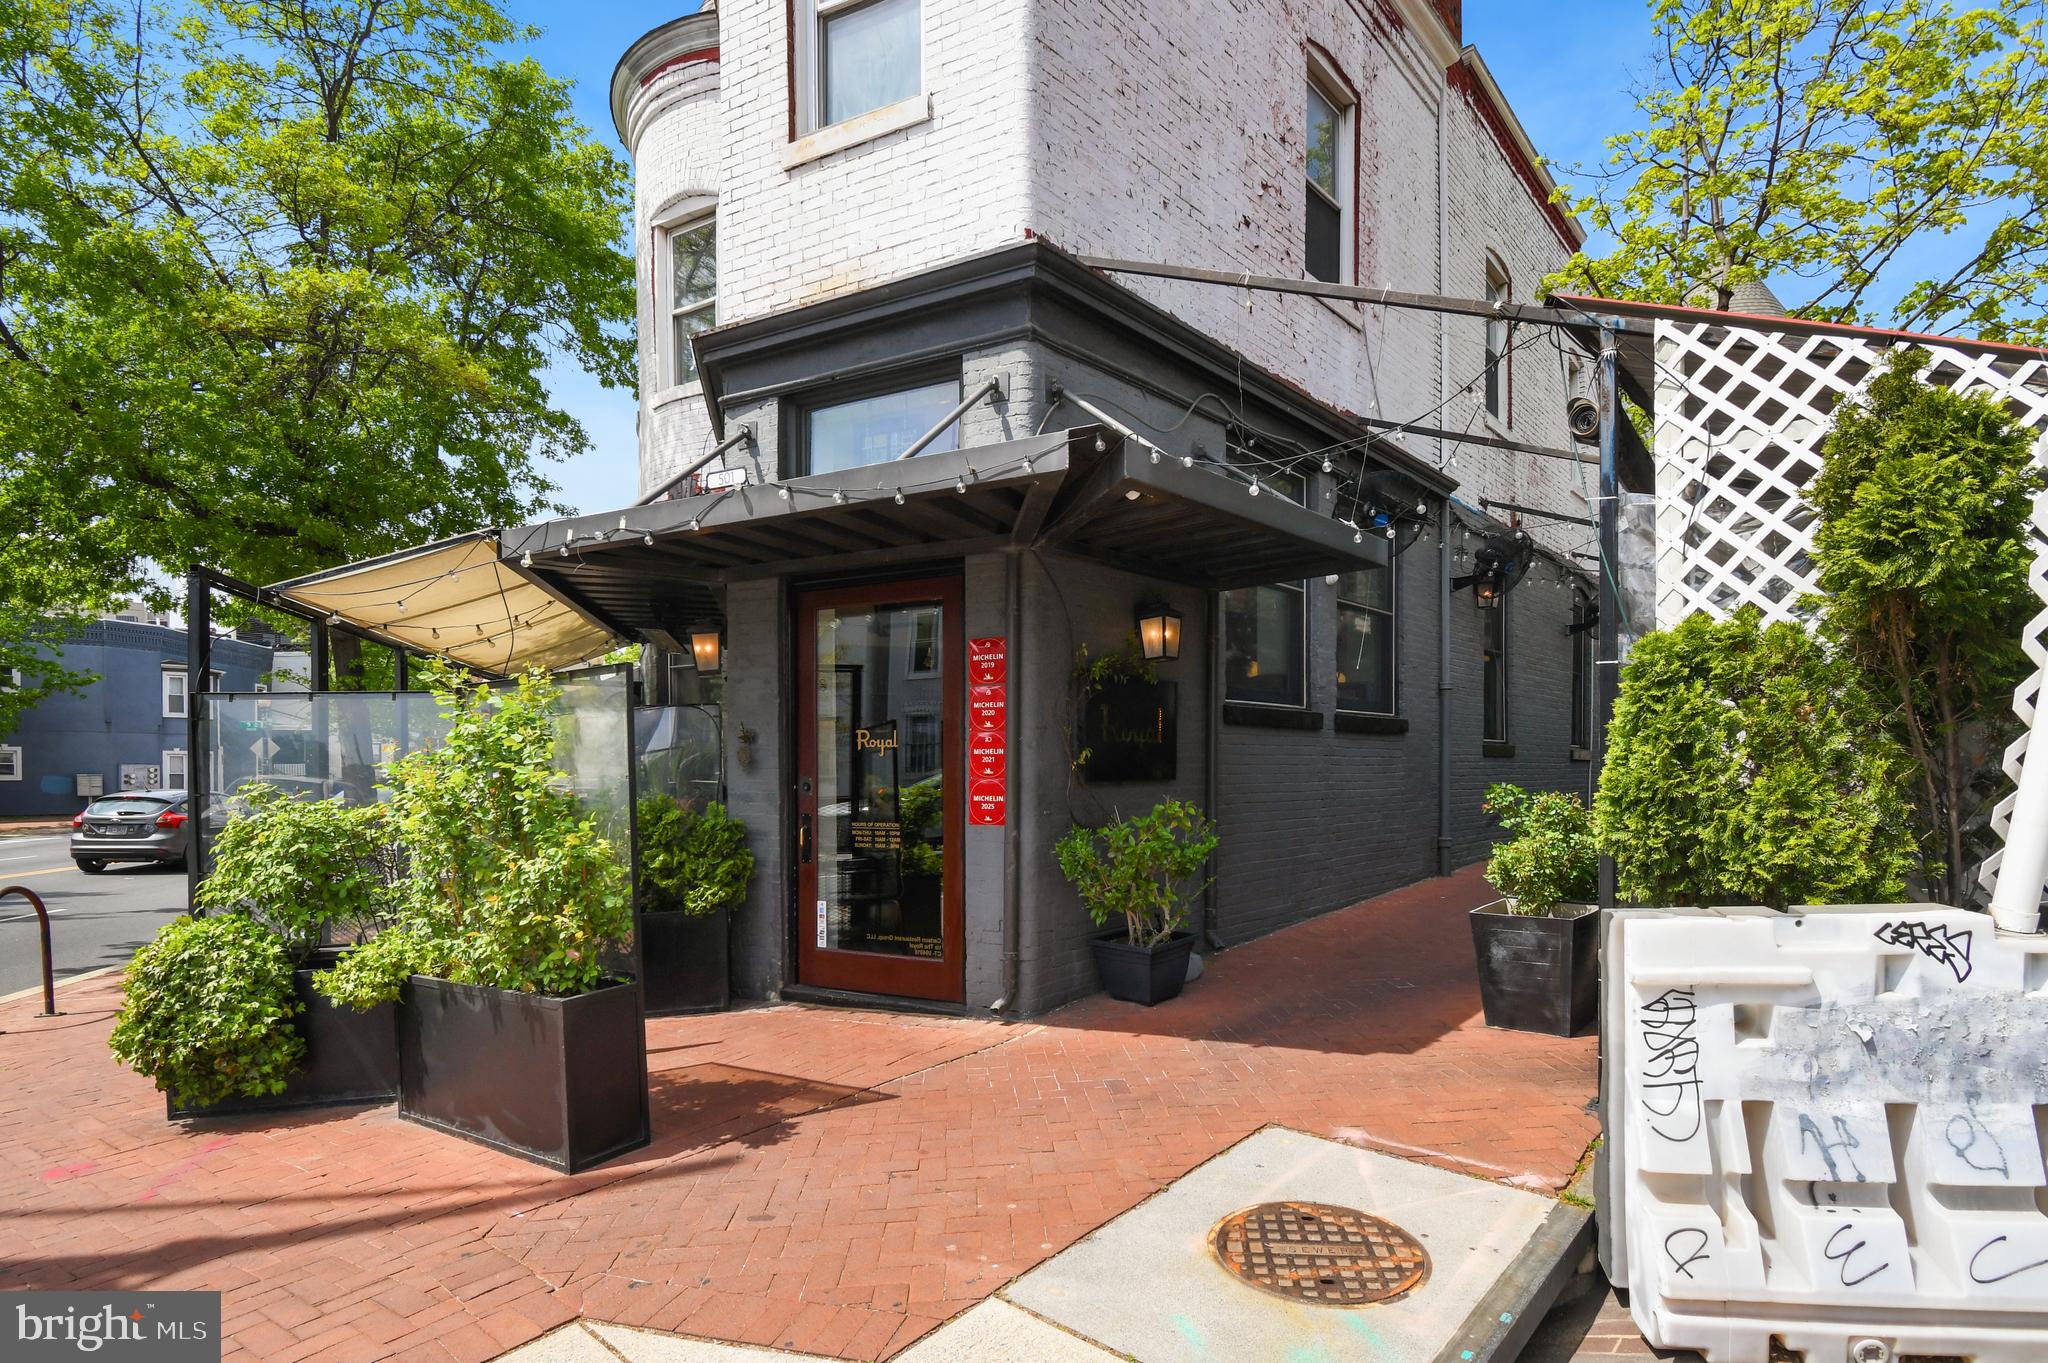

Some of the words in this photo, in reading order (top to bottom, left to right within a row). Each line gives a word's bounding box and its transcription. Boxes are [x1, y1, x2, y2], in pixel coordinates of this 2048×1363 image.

[719, 472, 735, 486] 501
[973, 653, 1004, 661] MICHELIN
[855, 729, 899, 758] Royal
